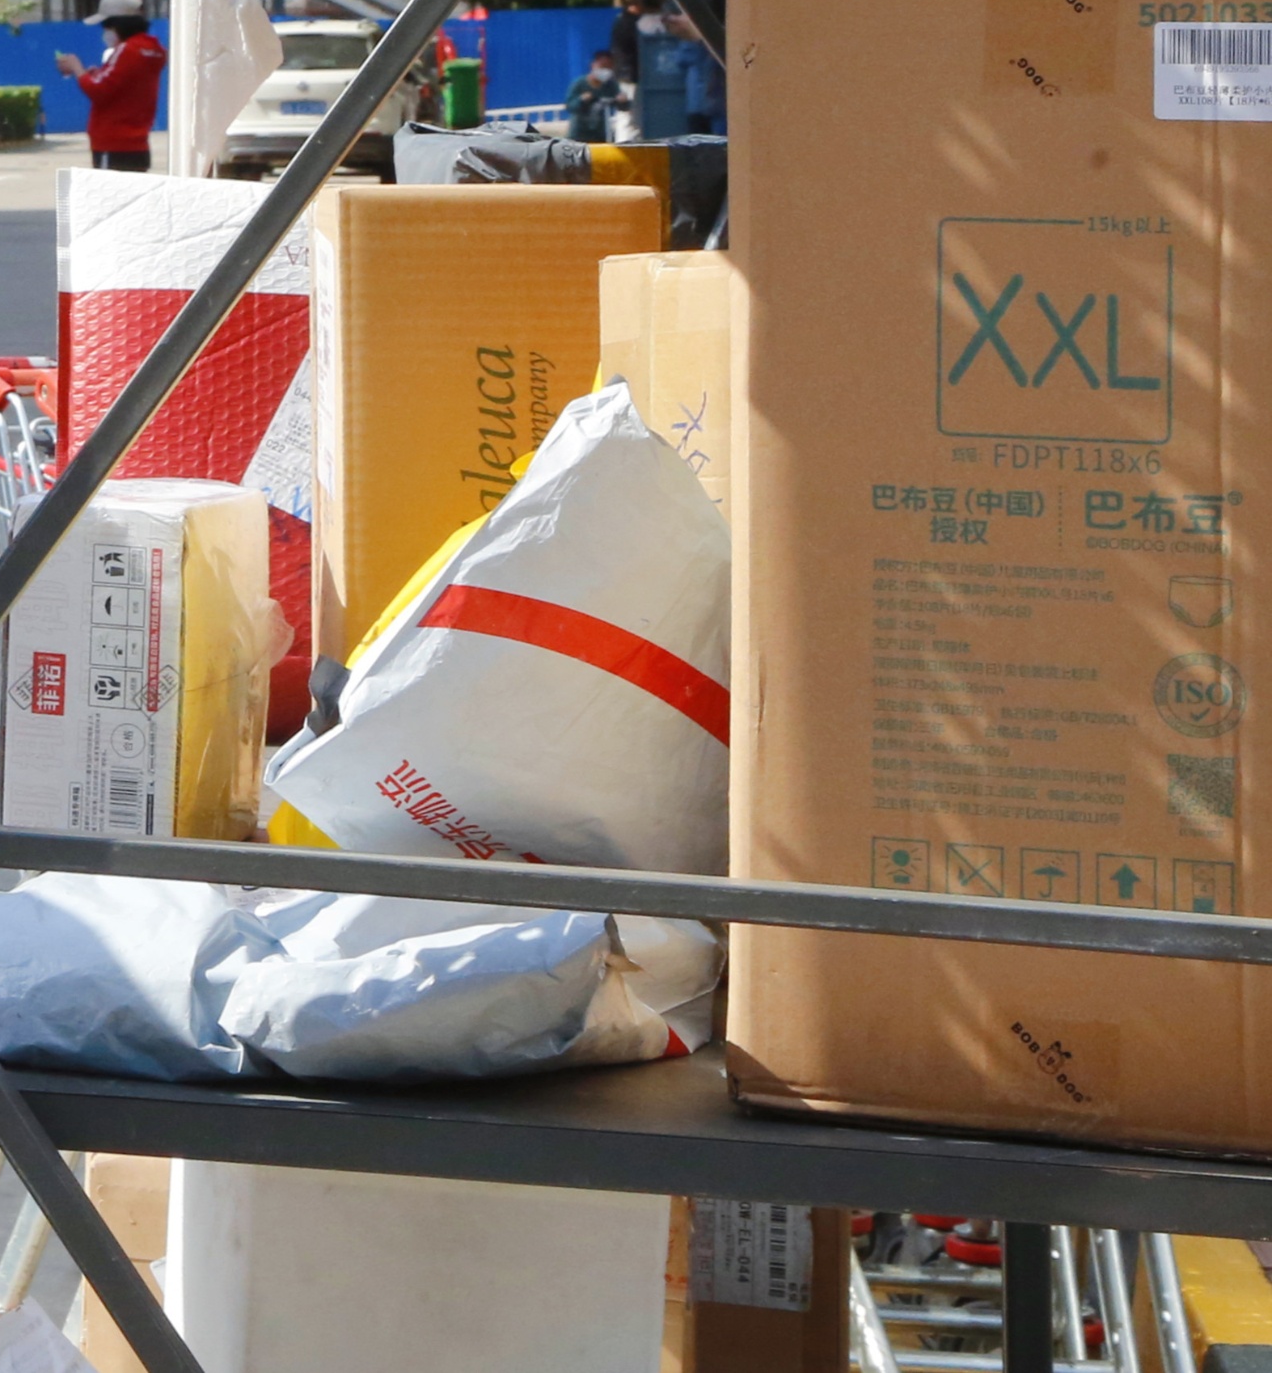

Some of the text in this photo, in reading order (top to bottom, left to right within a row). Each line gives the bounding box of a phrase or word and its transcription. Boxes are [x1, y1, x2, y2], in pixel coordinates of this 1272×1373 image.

[1017, 58, 1044, 87] DOG
[1087, 215, 1171, 238] 15kg以上
[948, 272, 1162, 392] XXL
[264, 438, 287, 455] 022
[459, 344, 517, 527] aleuca
[993, 443, 1162, 476] FDPT118x6
[929, 517, 990, 546] 授权
[1173, 678, 1232, 706] ISO
[123, 729, 135, 752] 合格
[373, 758, 506, 859] 京东物流
[1010, 1021, 1084, 1105] BOB DOG
